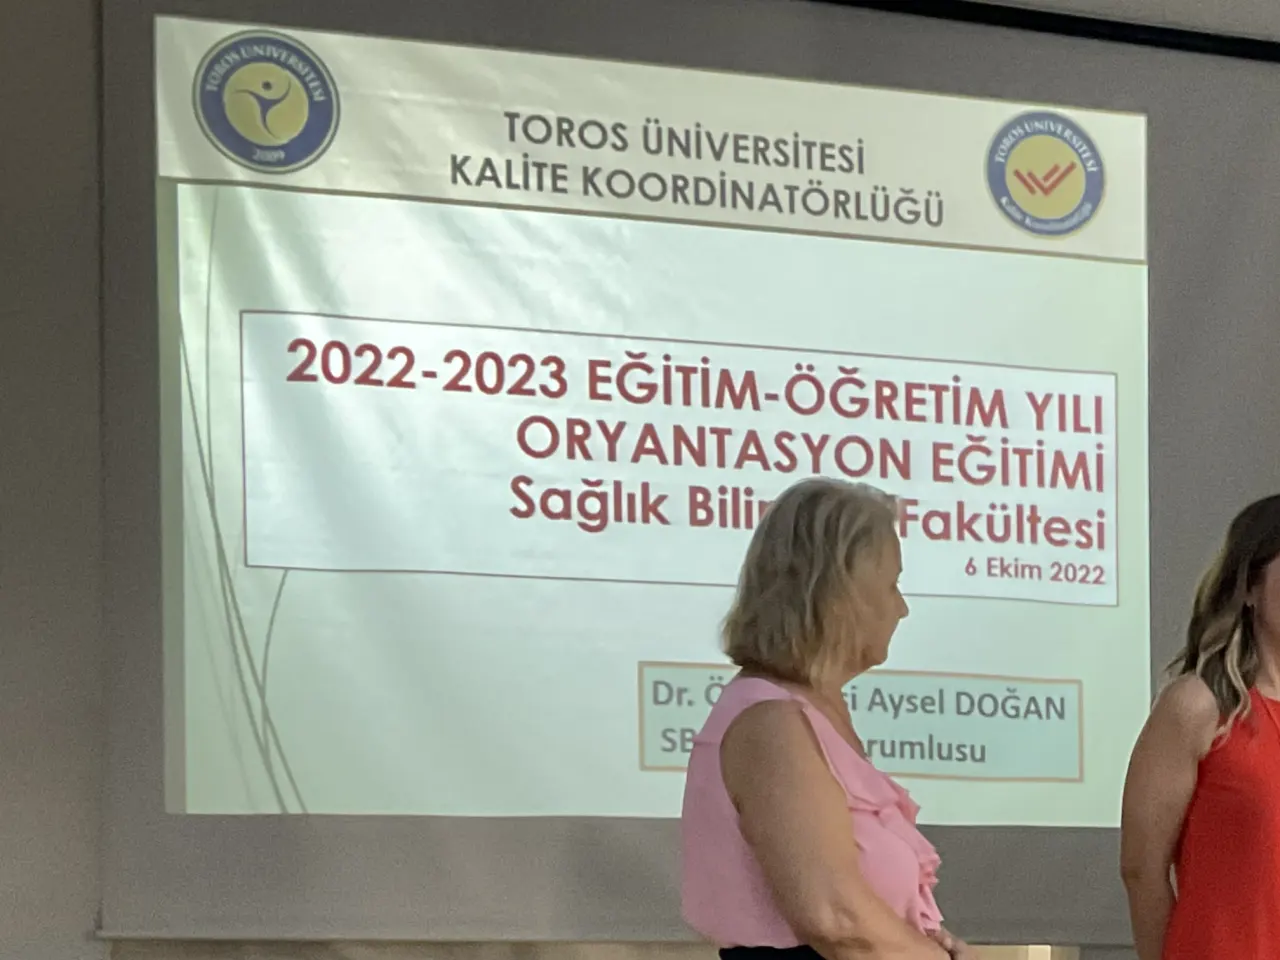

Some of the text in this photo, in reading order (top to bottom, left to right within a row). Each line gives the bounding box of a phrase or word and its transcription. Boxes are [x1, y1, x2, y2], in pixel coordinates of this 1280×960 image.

[504, 112, 866, 175] TOROS ÜNİVERSİTESİ
[450, 152, 569, 194] KALİTE
[582, 164, 945, 228] KOORDİNATÖRLÜĞÜ
[286, 337, 1103, 435] 2022-2023 EĞİTİM-ÖĞRETİM YILI
[516, 415, 1104, 493] ORYANTASYON EĞİTİMİ
[509, 475, 671, 533] Sağlık
[899, 497, 1106, 550] Fakültesi
[964, 556, 1106, 586] 6 Ekim 2022
[652, 680, 695, 707] Dr.
[867, 687, 945, 720] Aysel
[955, 686, 1066, 720] DOĞAN
[661, 727, 987, 763] SB rumlusu
